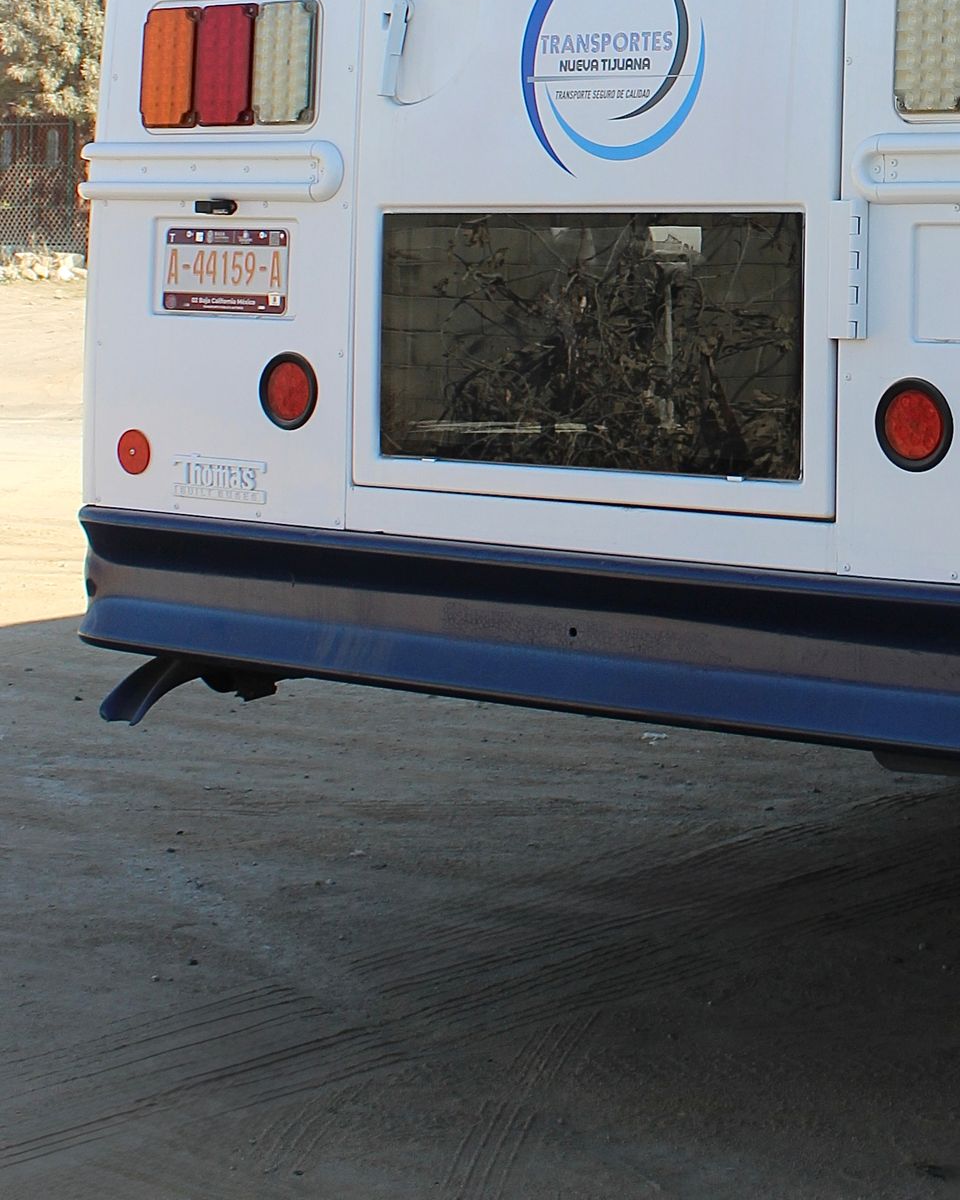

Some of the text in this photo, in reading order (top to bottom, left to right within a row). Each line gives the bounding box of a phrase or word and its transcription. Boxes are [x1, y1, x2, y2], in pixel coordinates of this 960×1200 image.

[541, 31, 673, 54] TRANSPORTES
[559, 57, 651, 72] NUEVA TIJUANA
[555, 89, 651, 100] TRANSPORTE SEGURO DE CALIDAD
[169, 233, 177, 243] T
[167, 249, 281, 288] A-44159-A
[173, 453, 267, 491] Thomas
